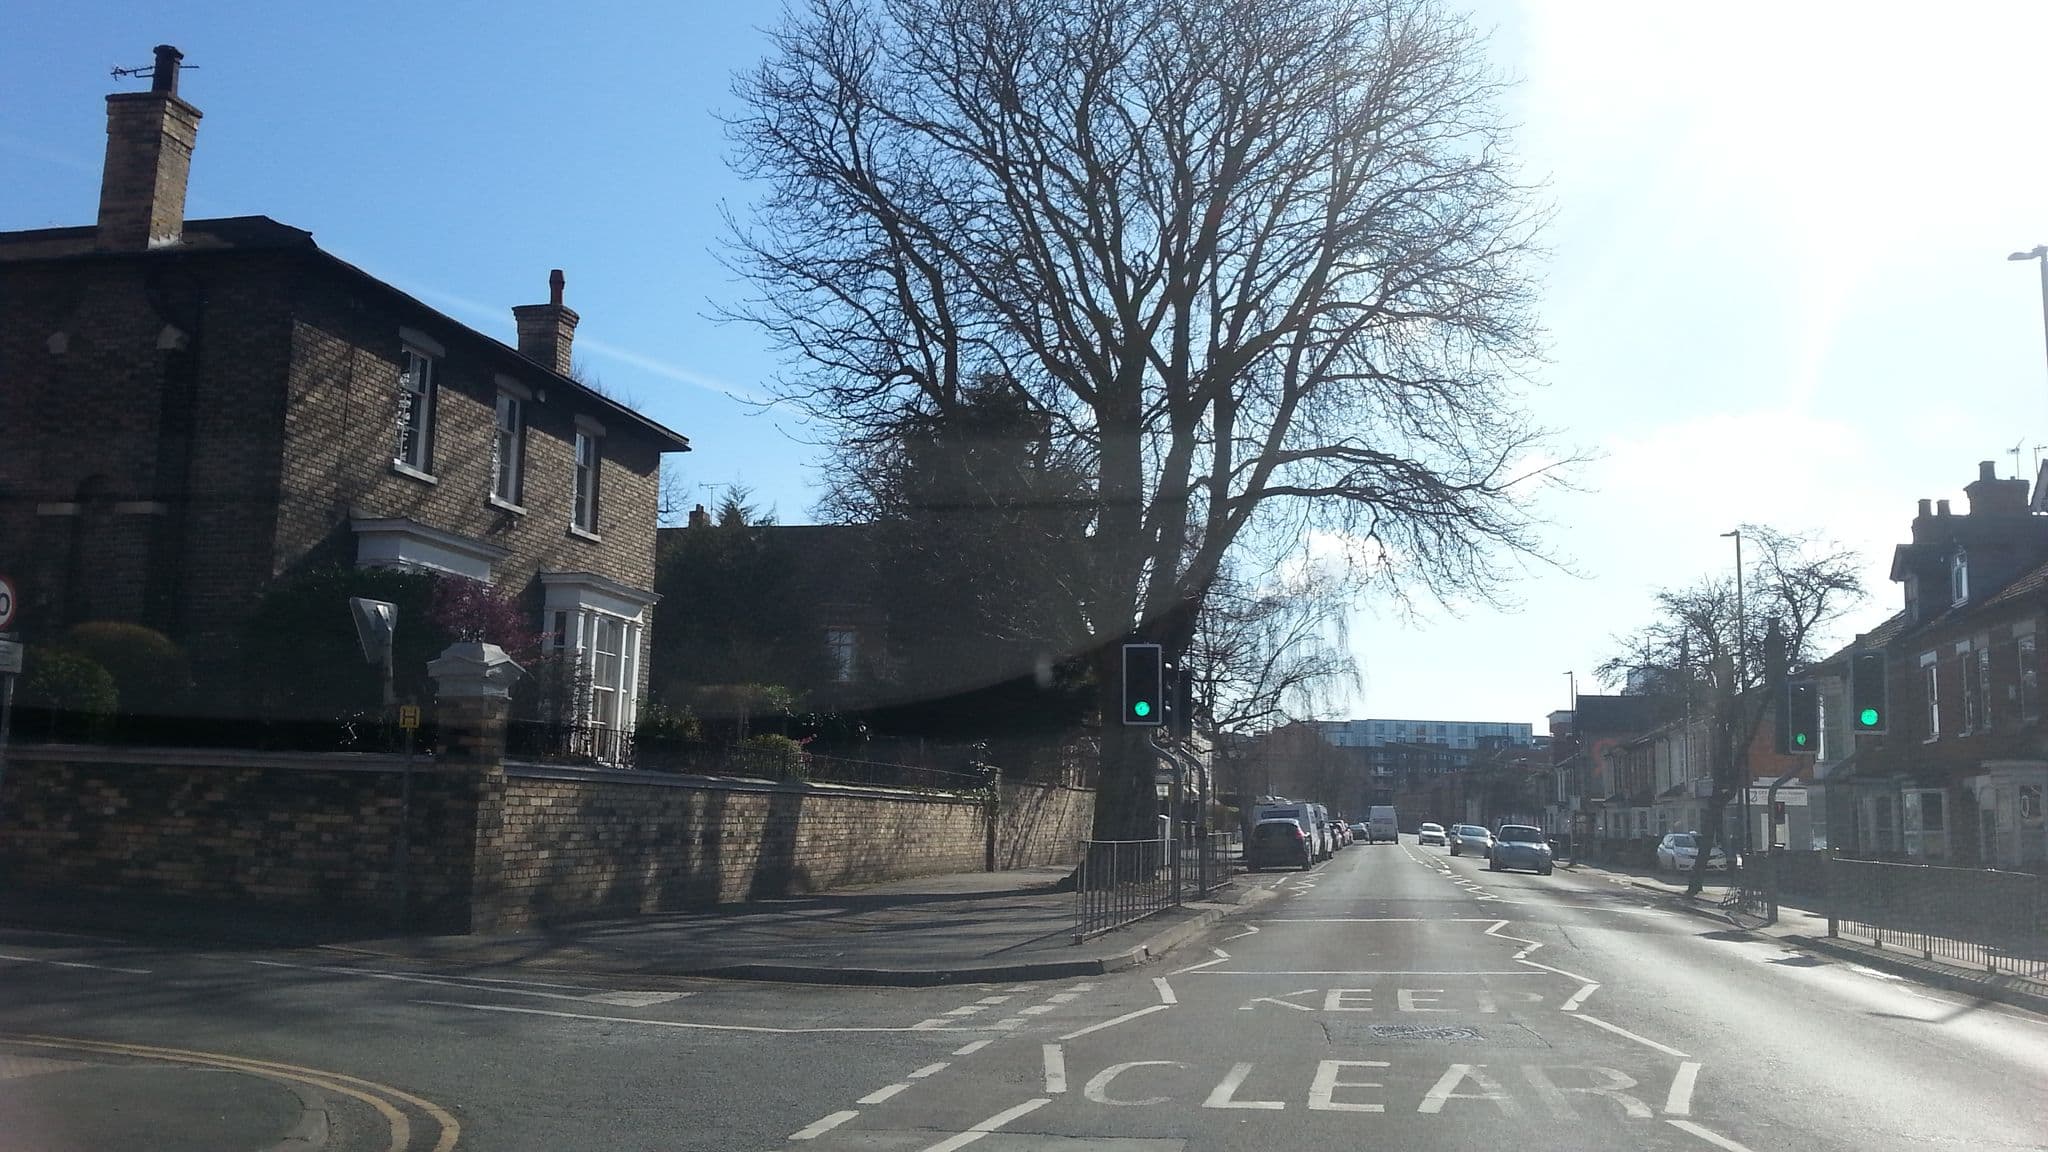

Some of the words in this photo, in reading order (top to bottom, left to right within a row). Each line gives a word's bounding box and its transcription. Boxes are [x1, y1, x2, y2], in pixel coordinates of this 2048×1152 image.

[402, 707, 417, 726] H
[1238, 988, 1544, 1013] KEEP
[1084, 1060, 1653, 1119] CLEAR
